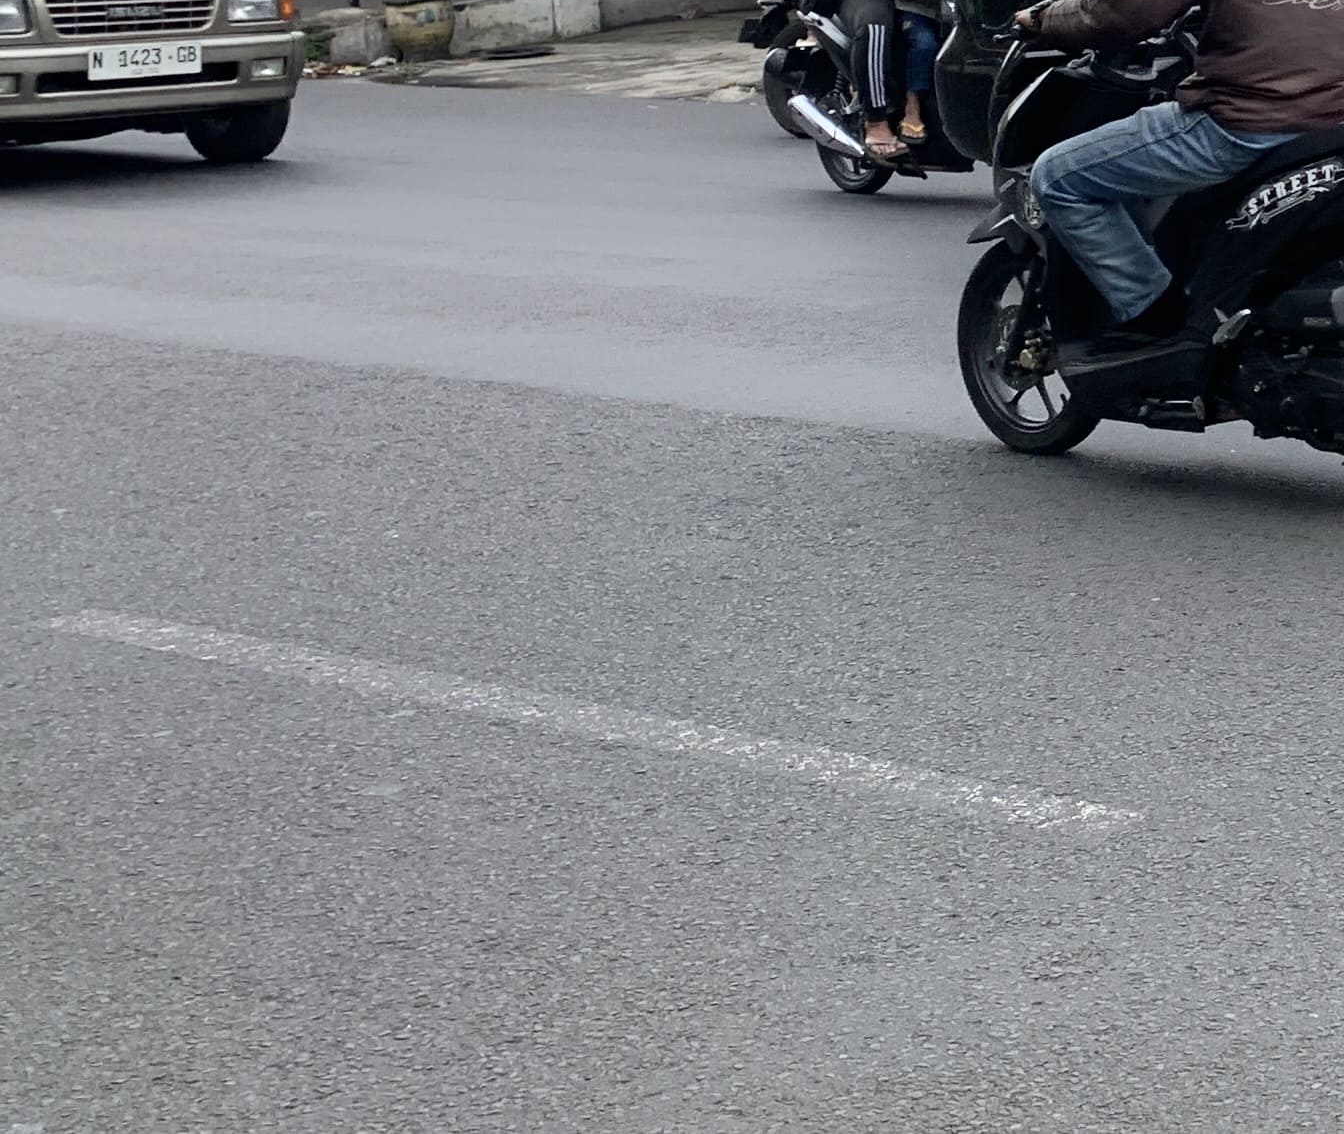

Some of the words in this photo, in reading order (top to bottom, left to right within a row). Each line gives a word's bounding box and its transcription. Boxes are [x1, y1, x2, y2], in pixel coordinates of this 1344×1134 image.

[93, 51, 103, 69] N
[118, 47, 162, 68] 1423
[177, 45, 198, 64] GB
[1247, 164, 1336, 216] STREET
